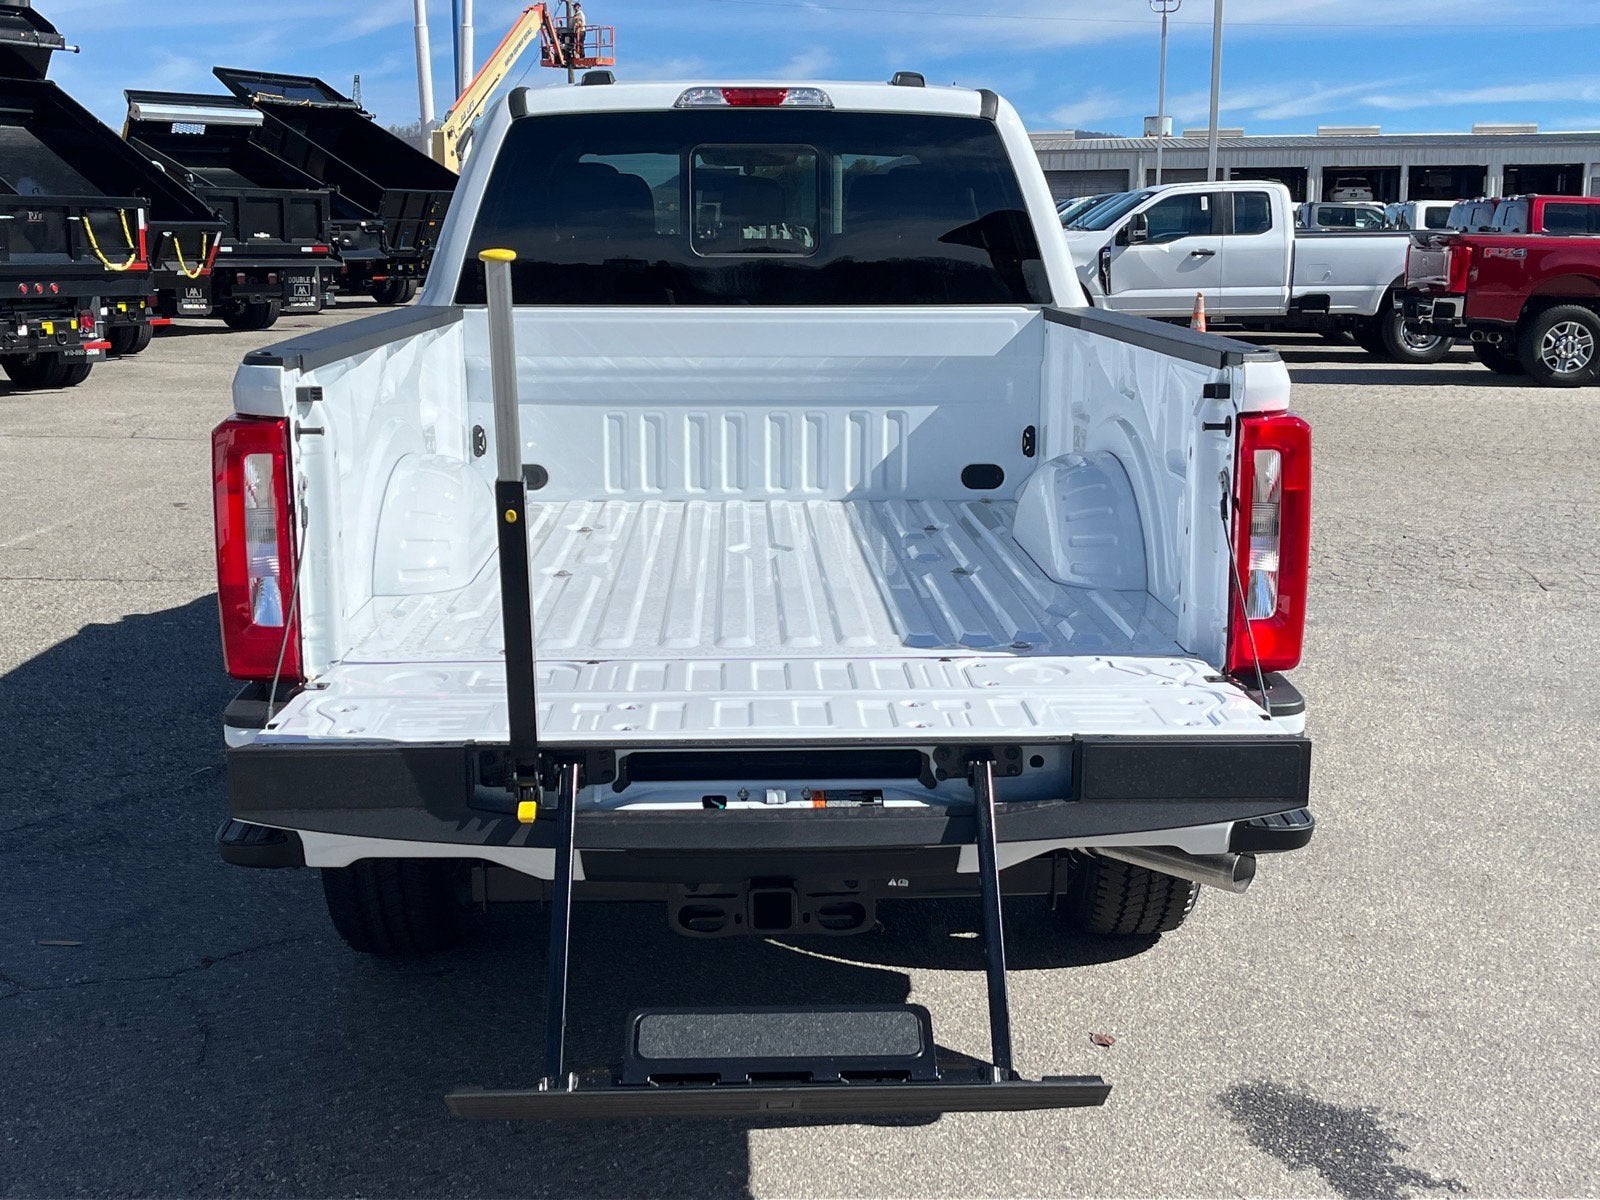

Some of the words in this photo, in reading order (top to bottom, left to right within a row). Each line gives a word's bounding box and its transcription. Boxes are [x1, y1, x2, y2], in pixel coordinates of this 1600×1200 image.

[1484, 247, 1527, 260] FX4
[288, 276, 310, 284] DOUBLE
[311, 276, 317, 284] A
